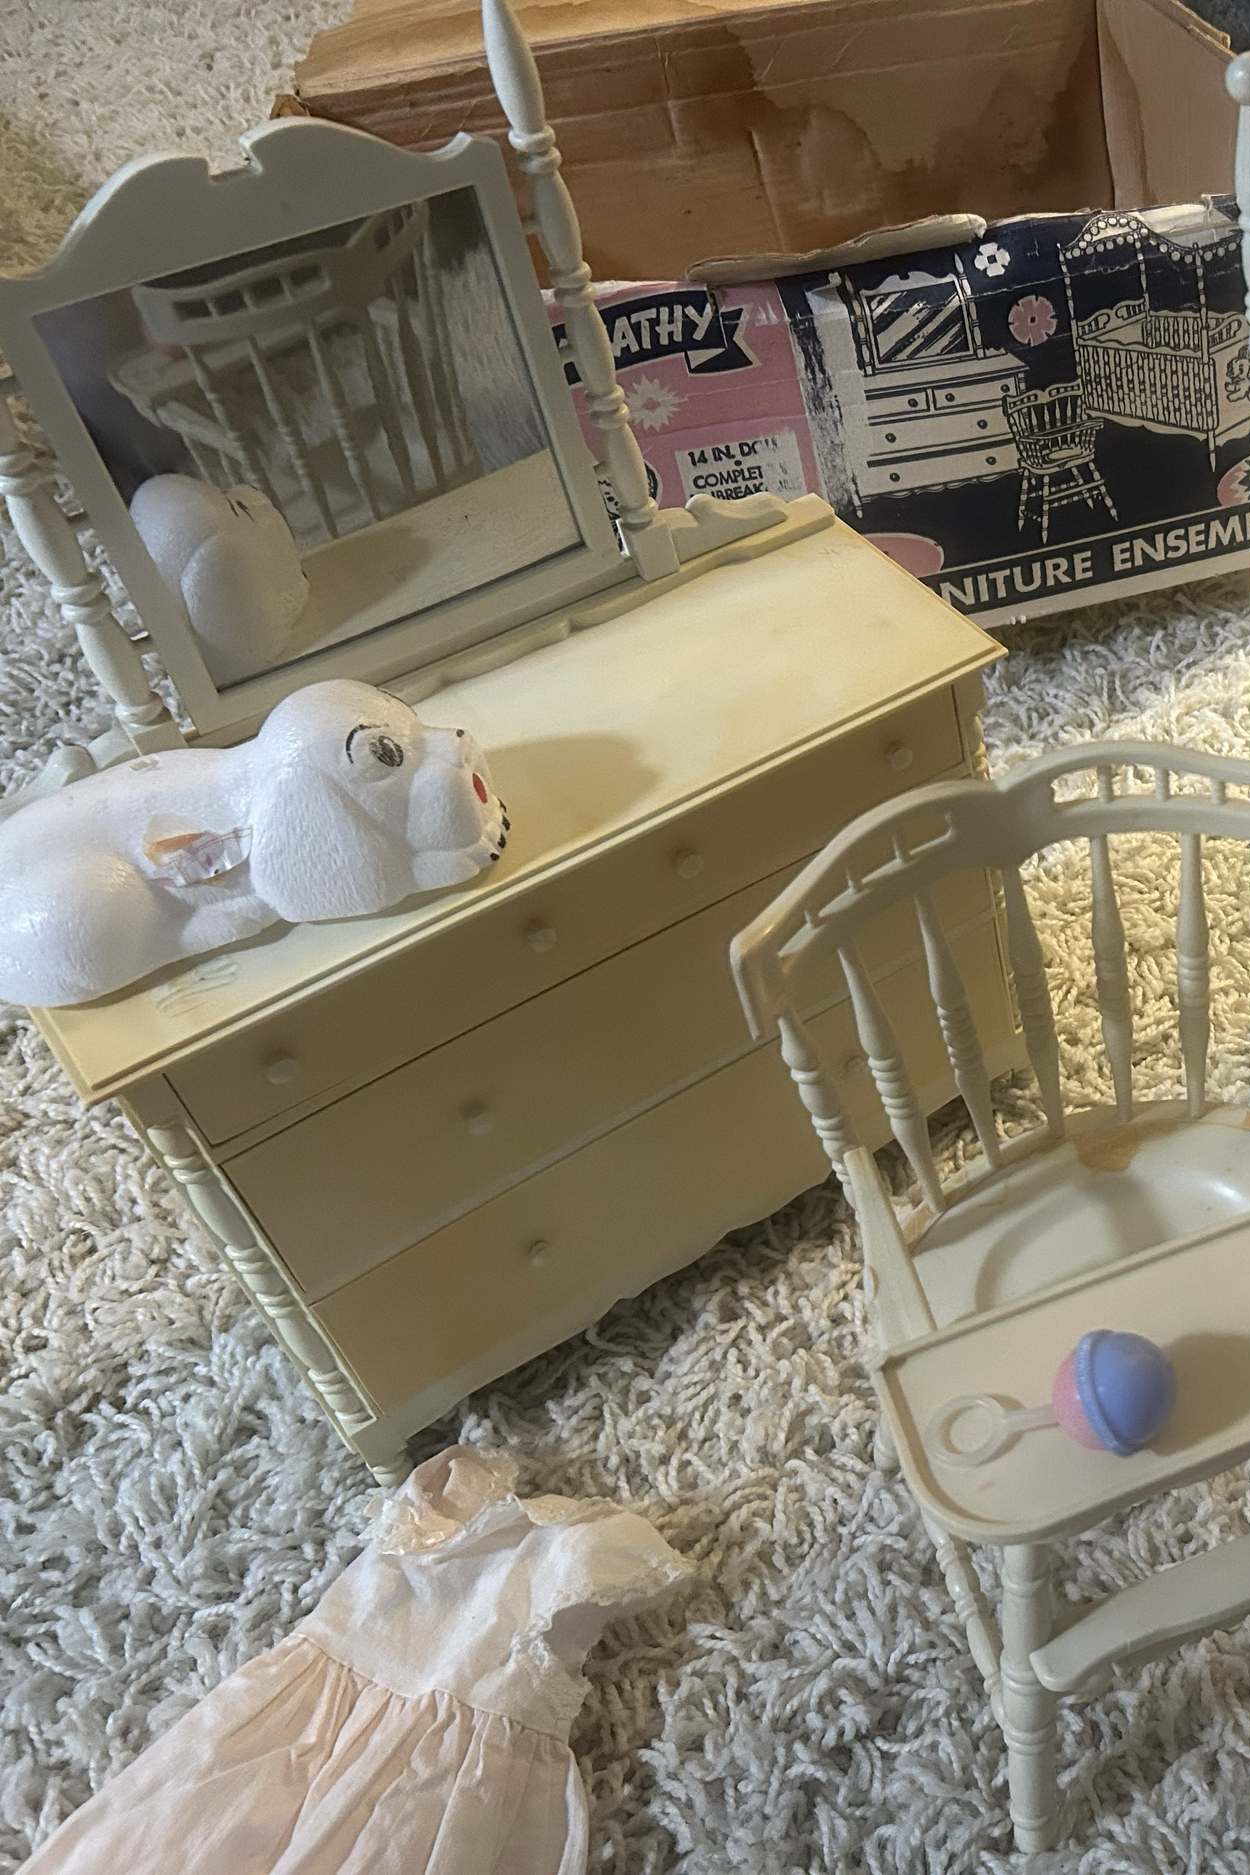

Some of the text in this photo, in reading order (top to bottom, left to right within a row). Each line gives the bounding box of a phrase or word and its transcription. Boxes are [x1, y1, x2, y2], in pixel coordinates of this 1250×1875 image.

[612, 304, 714, 358] ATHY
[688, 450, 709, 467] 14
[712, 445, 737, 462] IN.
[939, 550, 1093, 606] NITURE
